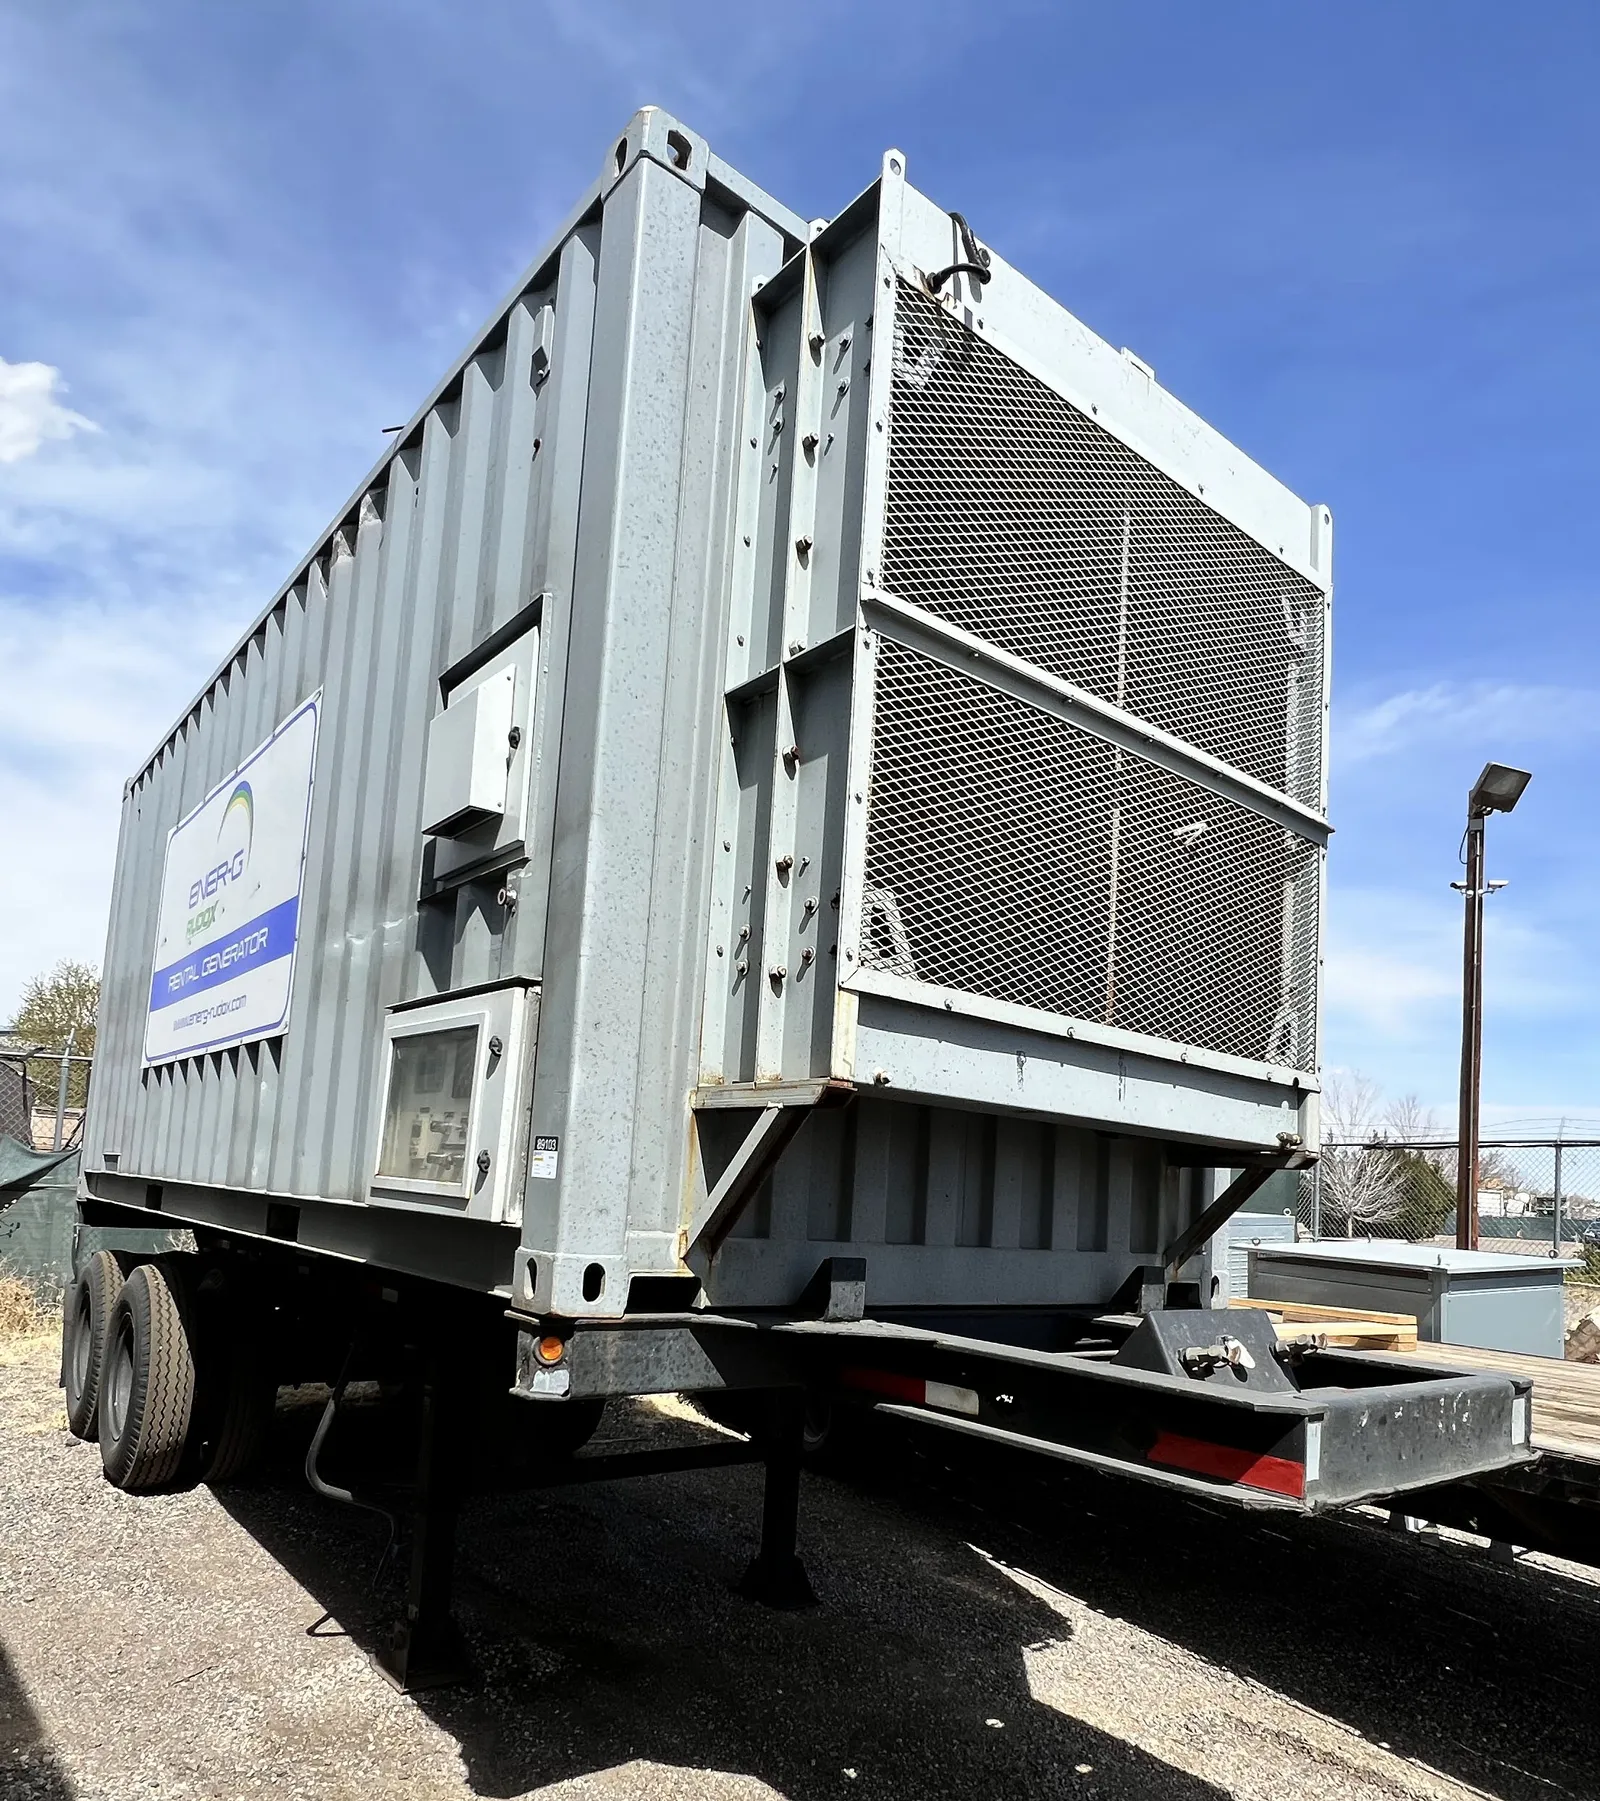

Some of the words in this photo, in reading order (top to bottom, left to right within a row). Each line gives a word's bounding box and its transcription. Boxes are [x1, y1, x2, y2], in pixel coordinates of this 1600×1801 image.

[189, 848, 244, 909] ENER-G
[168, 964, 200, 993] RENTAL
[201, 927, 269, 977] GENERATOR
[536, 1138, 557, 1151] 89103
